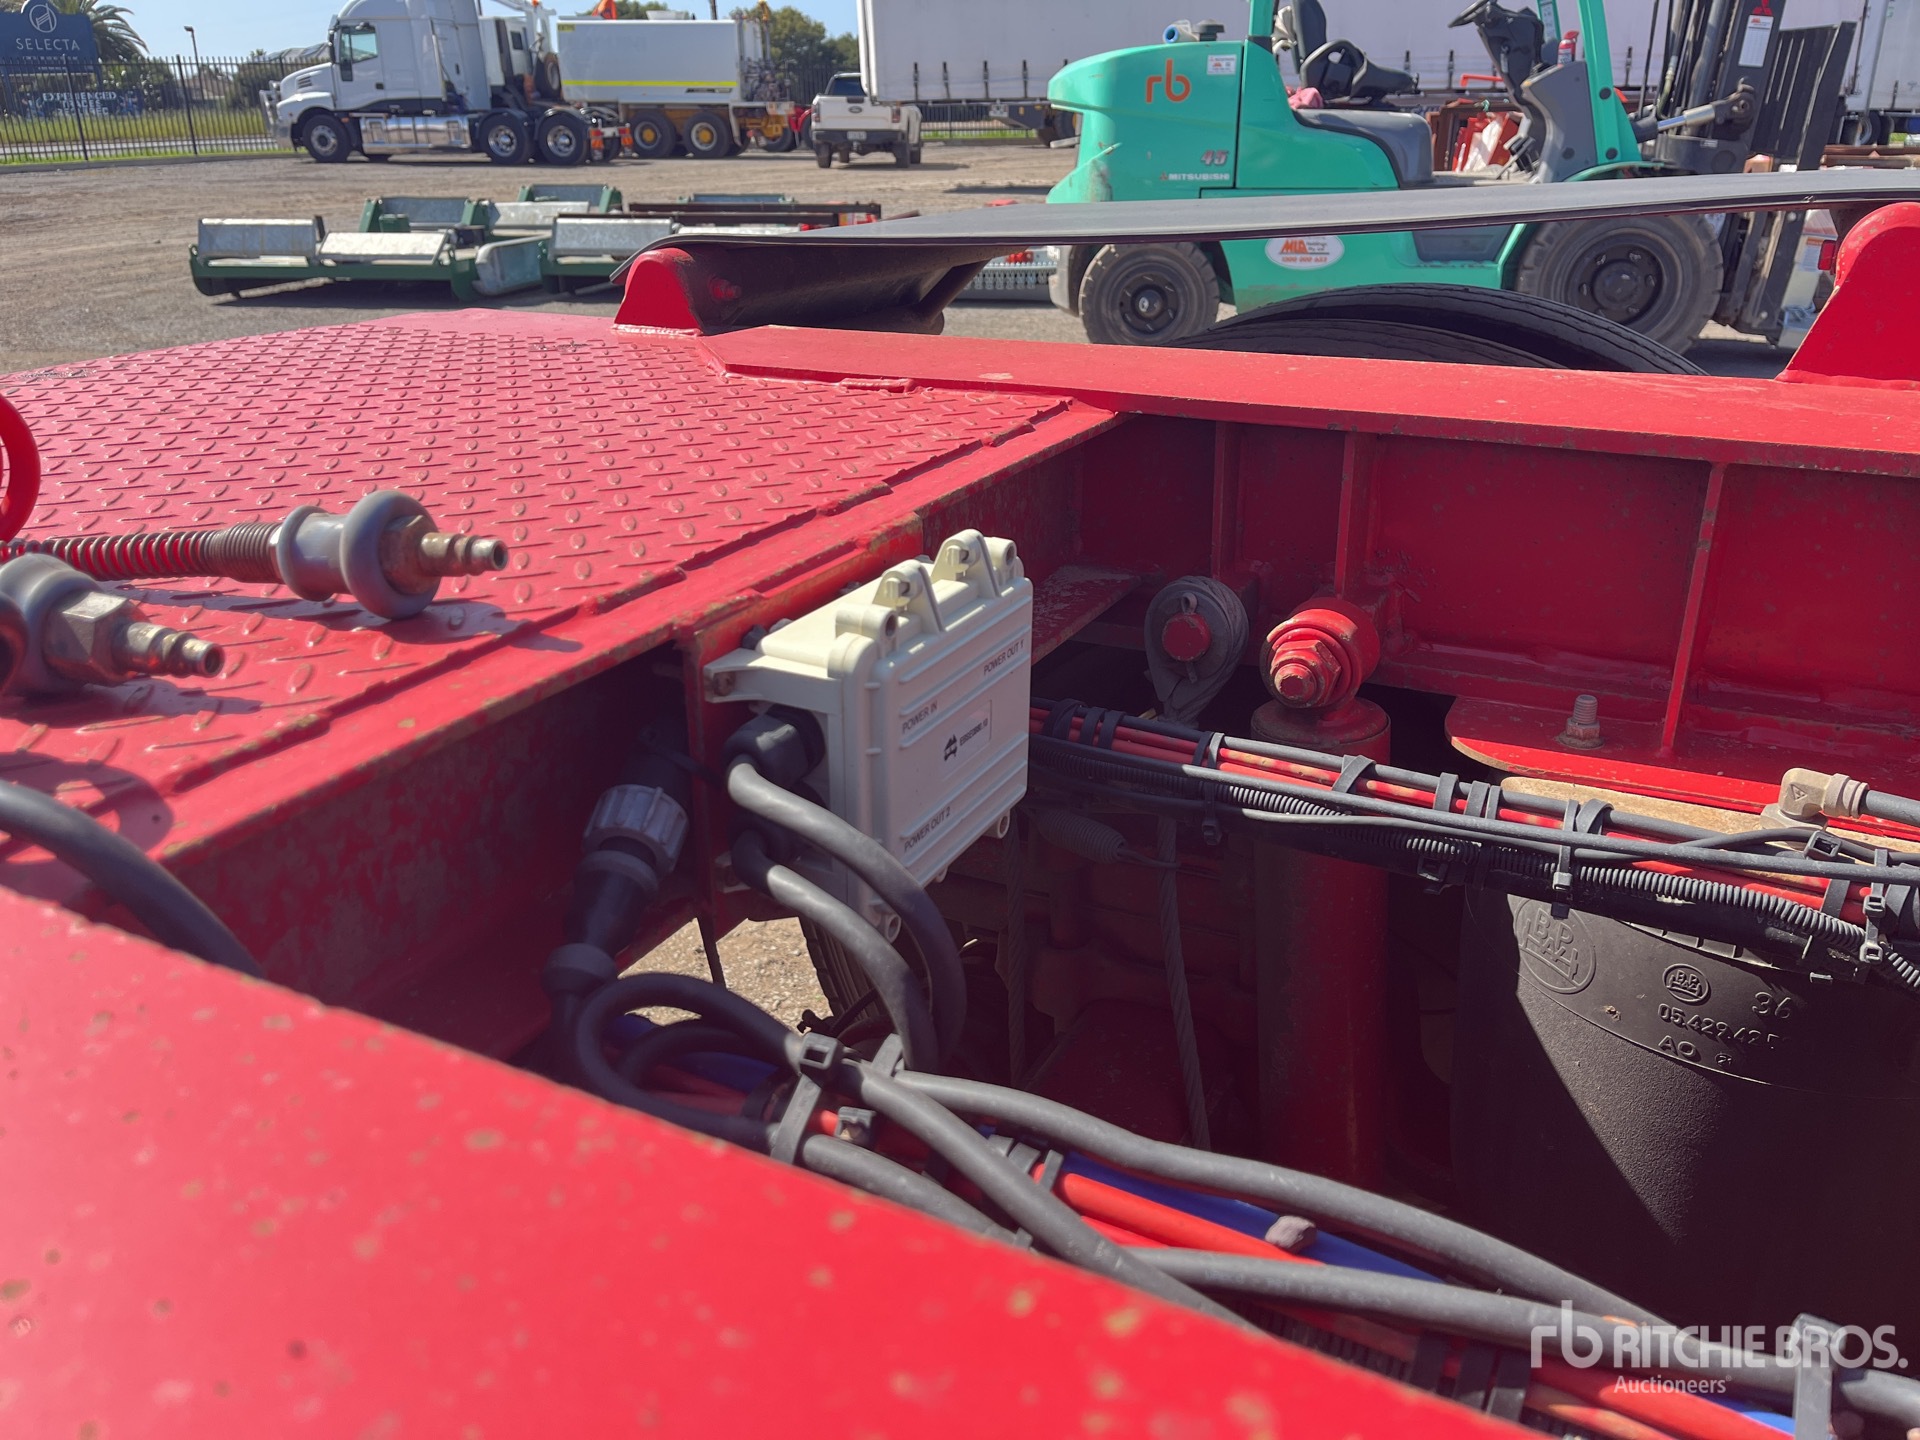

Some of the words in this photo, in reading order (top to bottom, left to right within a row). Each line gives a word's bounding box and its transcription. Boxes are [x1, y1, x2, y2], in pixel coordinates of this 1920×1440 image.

[15, 38, 80, 51] SELECTA
[1145, 58, 1192, 103] rb
[1201, 149, 1229, 166] 45
[1168, 173, 1230, 181] MITSUBISHI
[1280, 239, 1308, 254] MLA
[984, 652, 1006, 676] POWER
[1007, 642, 1019, 658] OUT
[902, 707, 929, 735] POWER
[930, 700, 937, 713] IN
[904, 824, 930, 853] POWER
[931, 810, 944, 829] OUT
[1752, 991, 1792, 1019] 36
